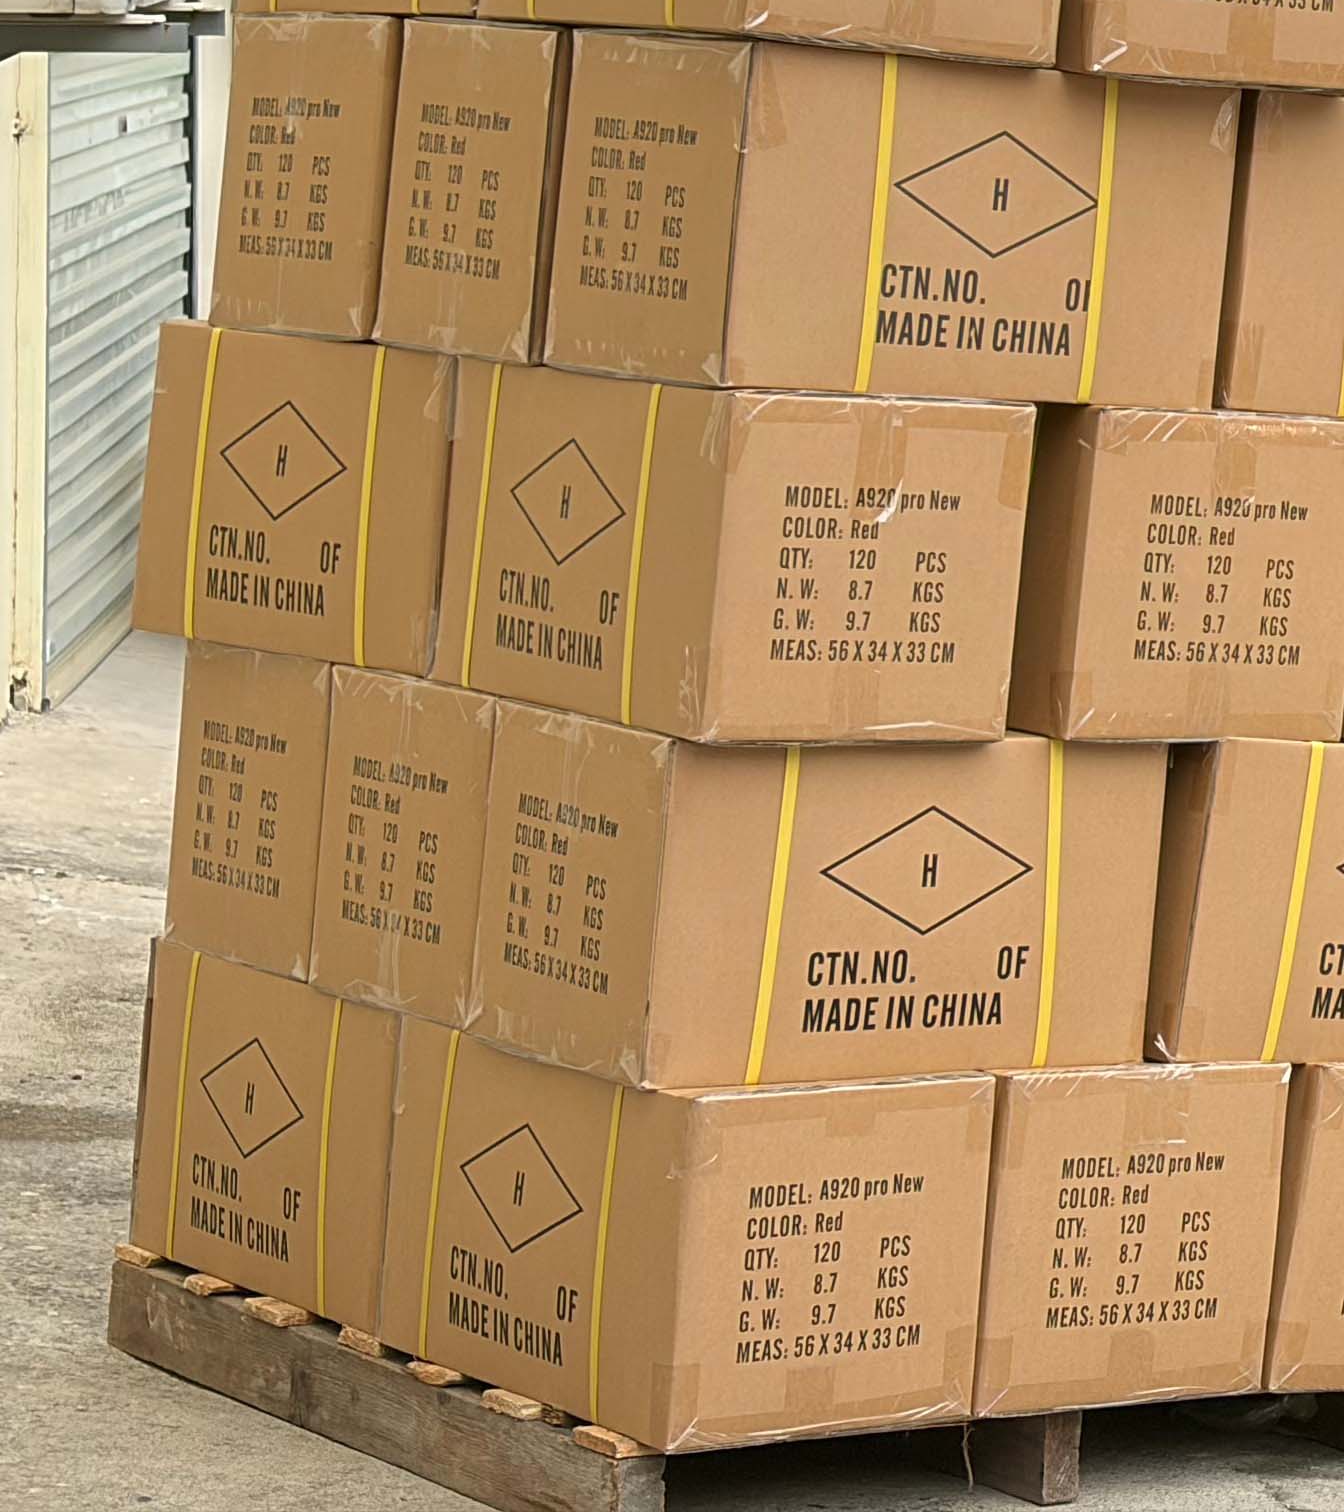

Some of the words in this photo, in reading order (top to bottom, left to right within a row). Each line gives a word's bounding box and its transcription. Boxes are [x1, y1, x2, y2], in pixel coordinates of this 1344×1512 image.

[594, 117, 629, 140] MODEL:
[632, 120, 658, 142] A920
[659, 128, 675, 146] pro
[677, 125, 697, 145] New
[591, 146, 624, 170] COLOR:
[628, 150, 646, 171] Red
[588, 176, 607, 198] QTY:
[627, 180, 642, 201] 120
[665, 185, 685, 208] PCS
[993, 178, 1009, 211] H
[624, 209, 640, 230] 8.7
[662, 216, 682, 238] KGS
[621, 241, 637, 262] 9.7
[659, 246, 679, 269] KGS
[580, 265, 608, 289] MEAS:
[611, 269, 624, 291] 56
[625, 271, 632, 292] X
[633, 272, 646, 295] 34
[648, 275, 655, 296] X
[657, 275, 669, 298] 33
[672, 278, 687, 300] CM
[881, 264, 985, 304] CTN.NO.
[875, 309, 950, 347] MADE
[957, 316, 984, 350] IN
[993, 319, 1069, 356] CHINA
[276, 445, 288, 477] H
[560, 485, 571, 519] H
[209, 525, 269, 564] CTN.NO.
[320, 541, 341, 574] OF
[206, 567, 249, 604] MADE
[254, 574, 269, 608] IN
[275, 578, 324, 616] CHINA
[500, 568, 554, 612] CTN.NO.
[600, 590, 619, 625] OF
[496, 613, 535, 654] MADE
[538, 623, 553, 659] IN
[558, 628, 602, 670] CHINA
[922, 854, 938, 887] H
[808, 950, 915, 986] CTN.NO.
[998, 946, 1029, 979] OF
[802, 997, 879, 1032] MADE
[886, 996, 915, 1029] IN
[923, 992, 1001, 1028] CHINA
[245, 1082, 254, 1115] H
[192, 1153, 242, 1203] CTN.NO.
[284, 1187, 301, 1222] OF
[513, 1171, 525, 1206] H
[191, 1196, 225, 1238] MADE
[229, 1211, 242, 1245] IN
[247, 1218, 288, 1262] CHINA
[449, 1245, 509, 1301] CTN.NO.
[557, 1286, 578, 1323] OF
[449, 1292, 489, 1338] MADE
[494, 1308, 509, 1346] IN
[514, 1310, 563, 1366] CHINA
